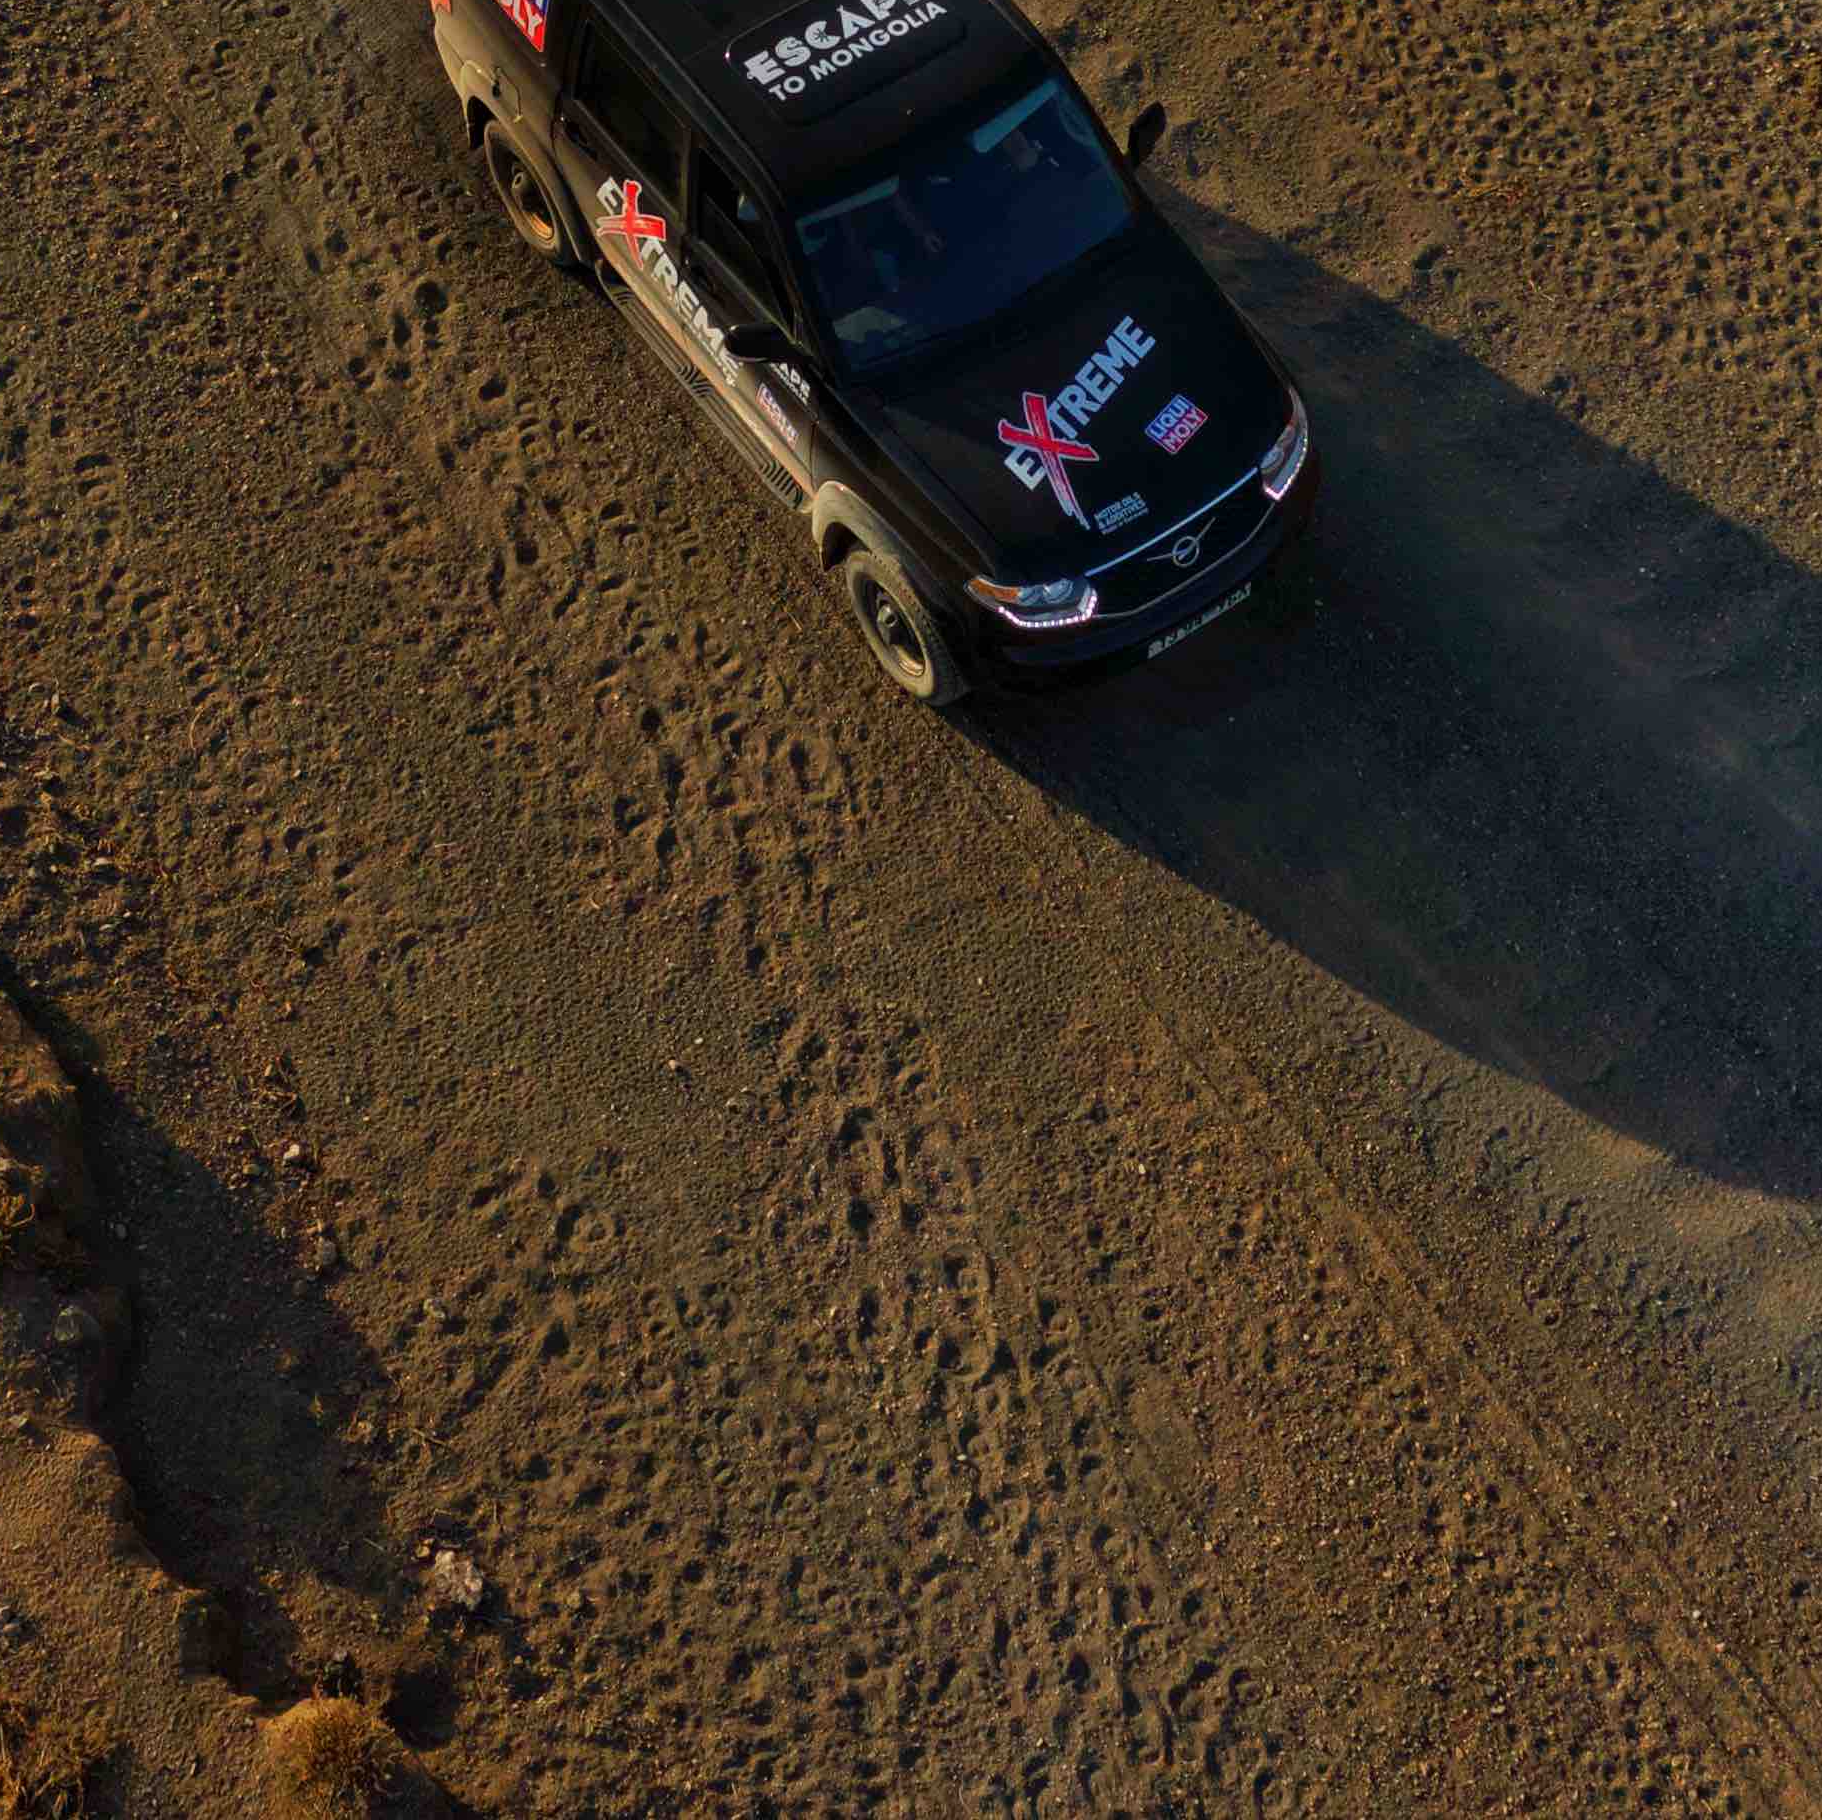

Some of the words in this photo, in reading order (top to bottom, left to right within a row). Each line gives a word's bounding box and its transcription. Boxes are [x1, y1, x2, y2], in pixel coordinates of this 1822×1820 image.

[768, 75, 806, 101] TO
[809, 1, 948, 81] MONGOLIA
[596, 176, 739, 384] EXTREME
[998, 315, 1157, 531] EXTREME
[1149, 398, 1190, 440] LIQUI
[1162, 407, 1203, 451] MOLY
